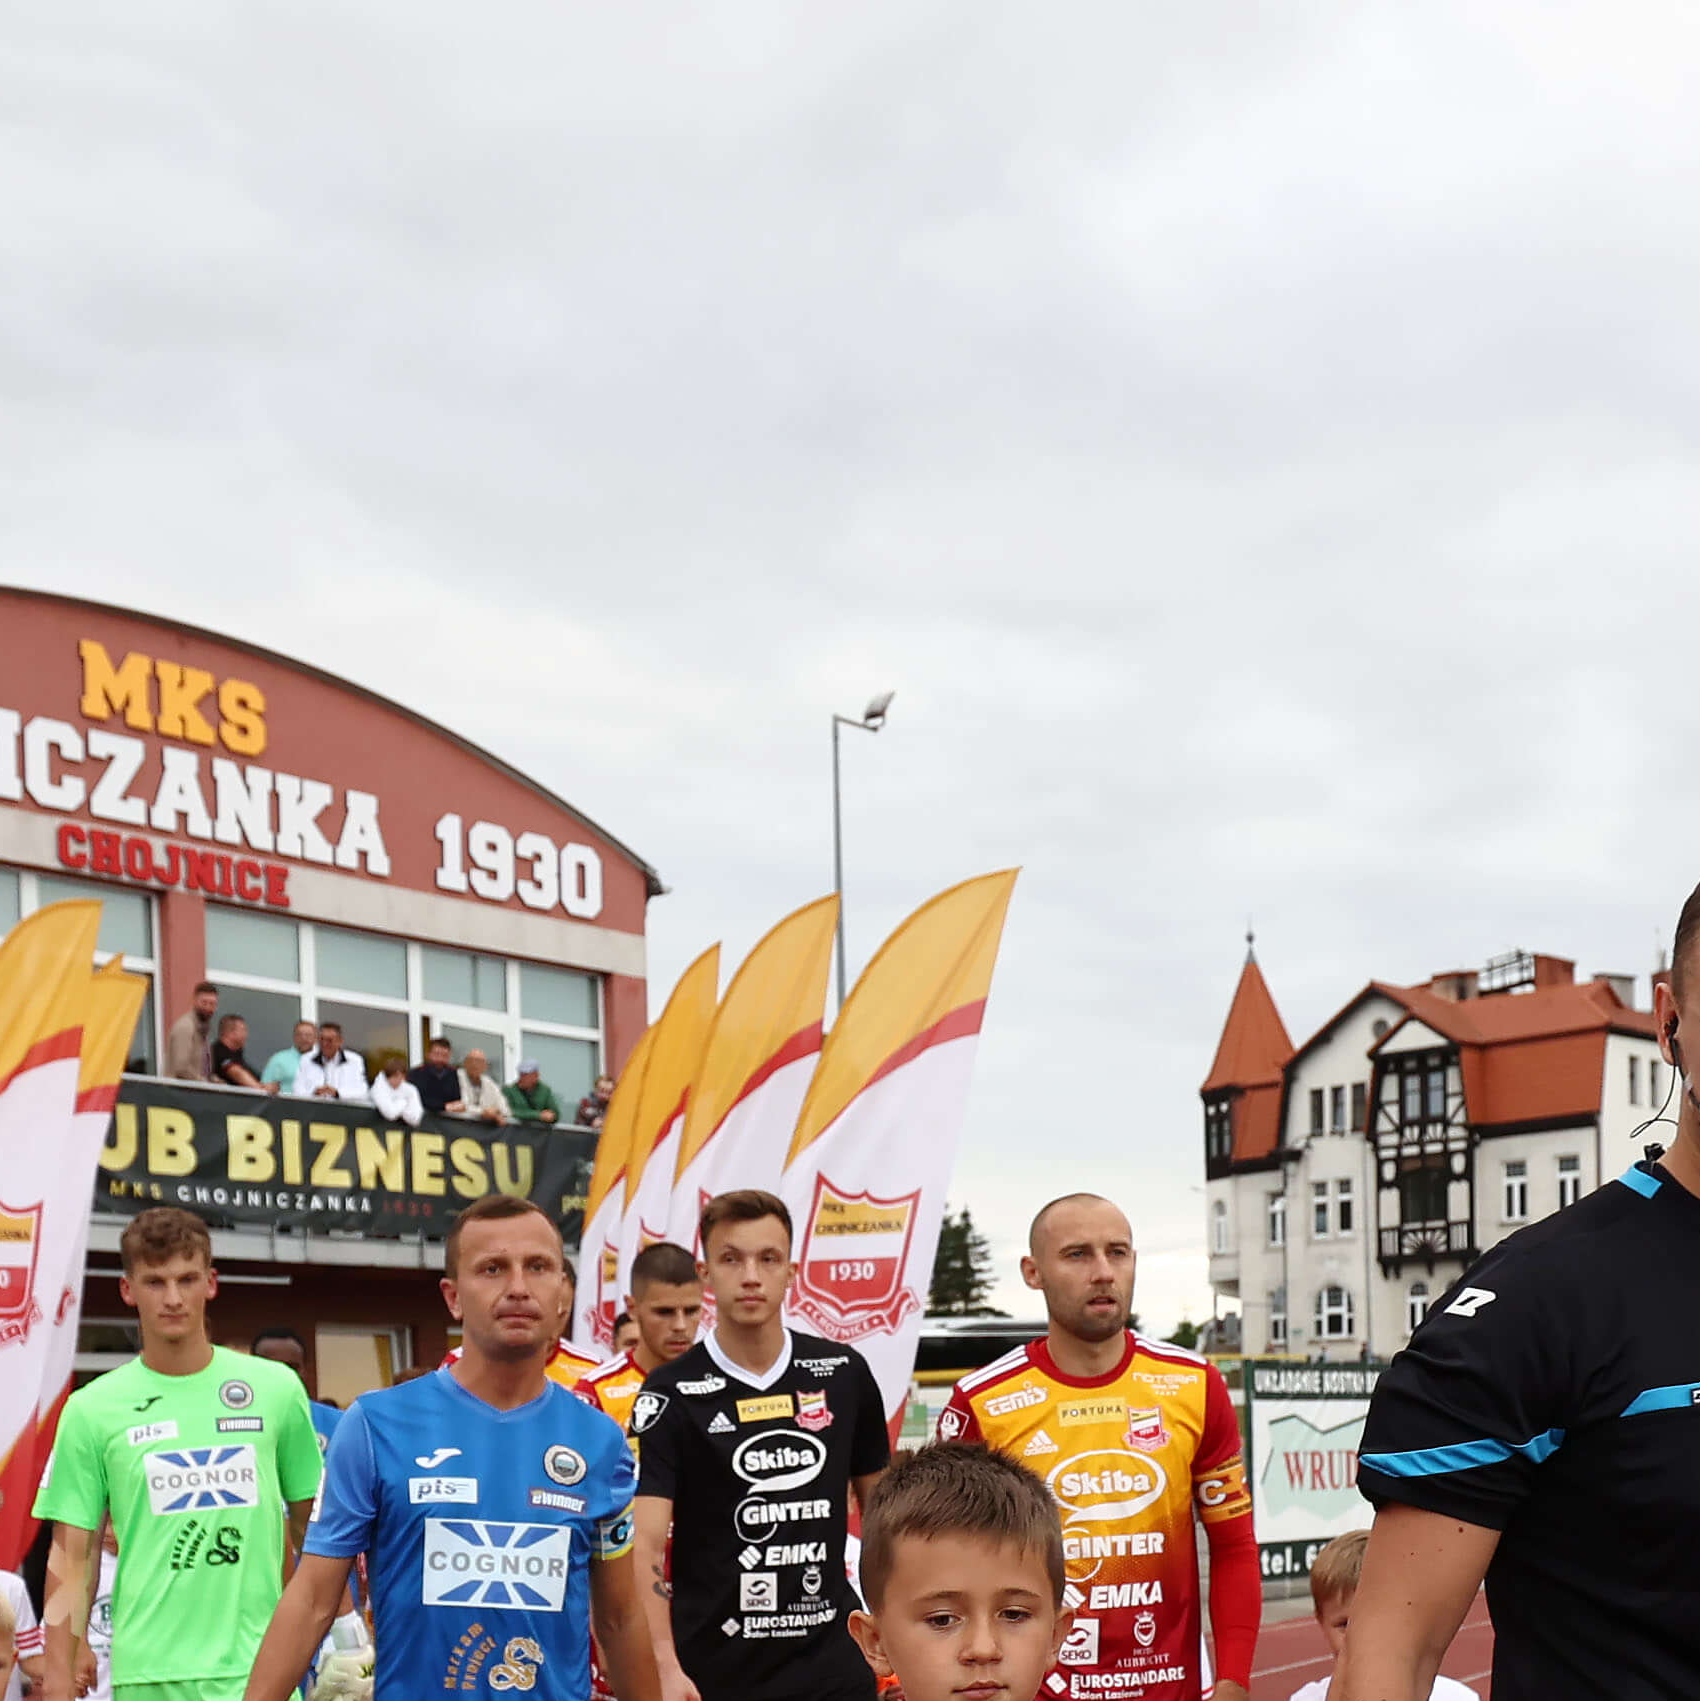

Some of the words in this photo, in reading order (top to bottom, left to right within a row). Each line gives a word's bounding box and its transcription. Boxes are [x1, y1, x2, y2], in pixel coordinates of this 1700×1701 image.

[78, 639, 268, 757] MKS
[56, 823, 292, 910] CHOJNICE
[434, 812, 604, 920] 1930
[97, 1102, 198, 1177] UB
[226, 1113, 534, 1200] BIZNESU
[177, 1185, 372, 1214] CHOJNICZANKA
[829, 1261, 876, 1282] 1930
[1062, 1404, 1123, 1418] FORTUNA
[744, 1447, 816, 1472] Skiba
[150, 1467, 255, 1491] COGNOR
[1060, 1470, 1152, 1497] Skiba
[1200, 1480, 1226, 1506] C
[742, 1499, 831, 1525] GINTER
[764, 1542, 828, 1567] EMKA
[1063, 1532, 1165, 1560] GINTER
[428, 1551, 565, 1580] COGNOR
[1089, 1581, 1163, 1610] EMKA
